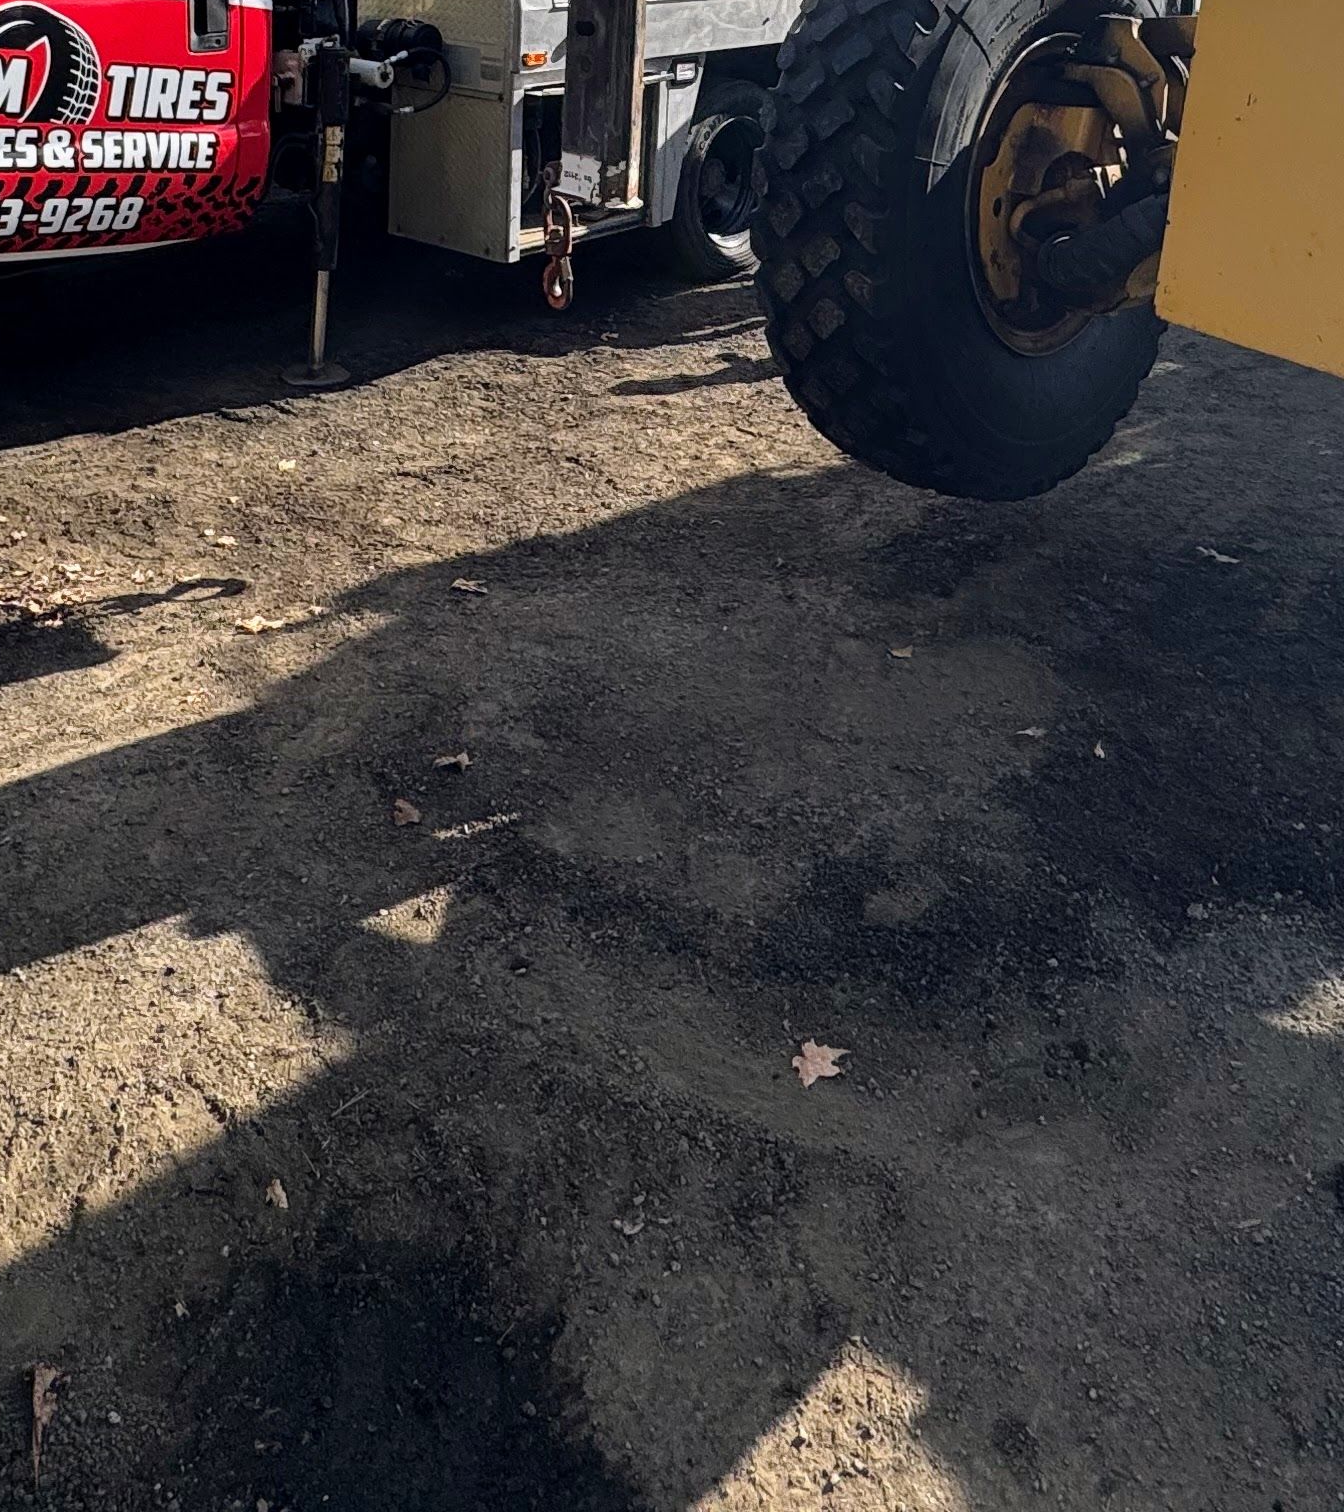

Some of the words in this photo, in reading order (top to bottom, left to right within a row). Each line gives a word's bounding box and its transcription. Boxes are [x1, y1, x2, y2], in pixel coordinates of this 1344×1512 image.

[106, 64, 233, 121] TIRES
[42, 129, 76, 169] &
[80, 130, 217, 170] SERVICE
